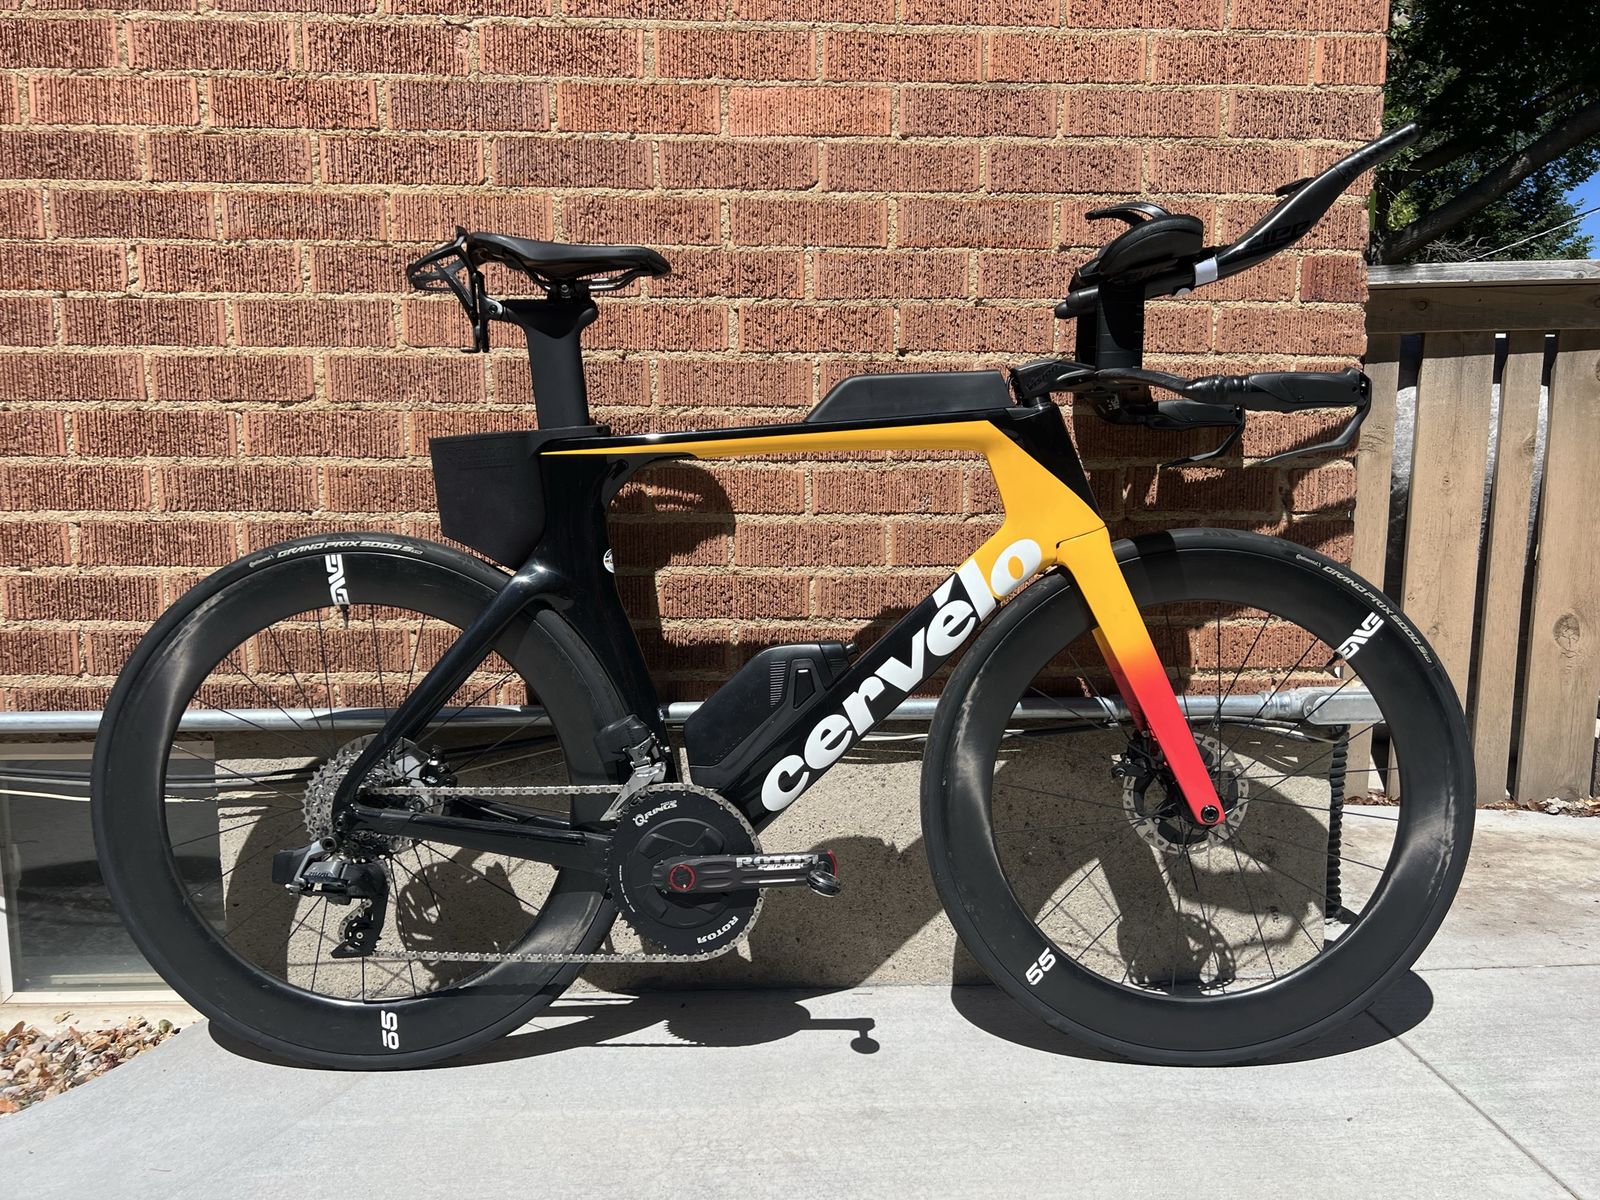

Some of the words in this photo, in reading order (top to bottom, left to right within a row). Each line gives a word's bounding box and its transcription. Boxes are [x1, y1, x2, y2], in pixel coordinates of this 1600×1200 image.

[277, 542, 323, 559] GRAND
[359, 541, 401, 550] 5000
[1322, 566, 1366, 593] GRAND
[1364, 592, 1394, 615] PRIX
[1390, 614, 1421, 645] 5000
[761, 539, 1042, 812] cervélo
[736, 854, 818, 868] ROTOR
[697, 915, 739, 944] ROTOR
